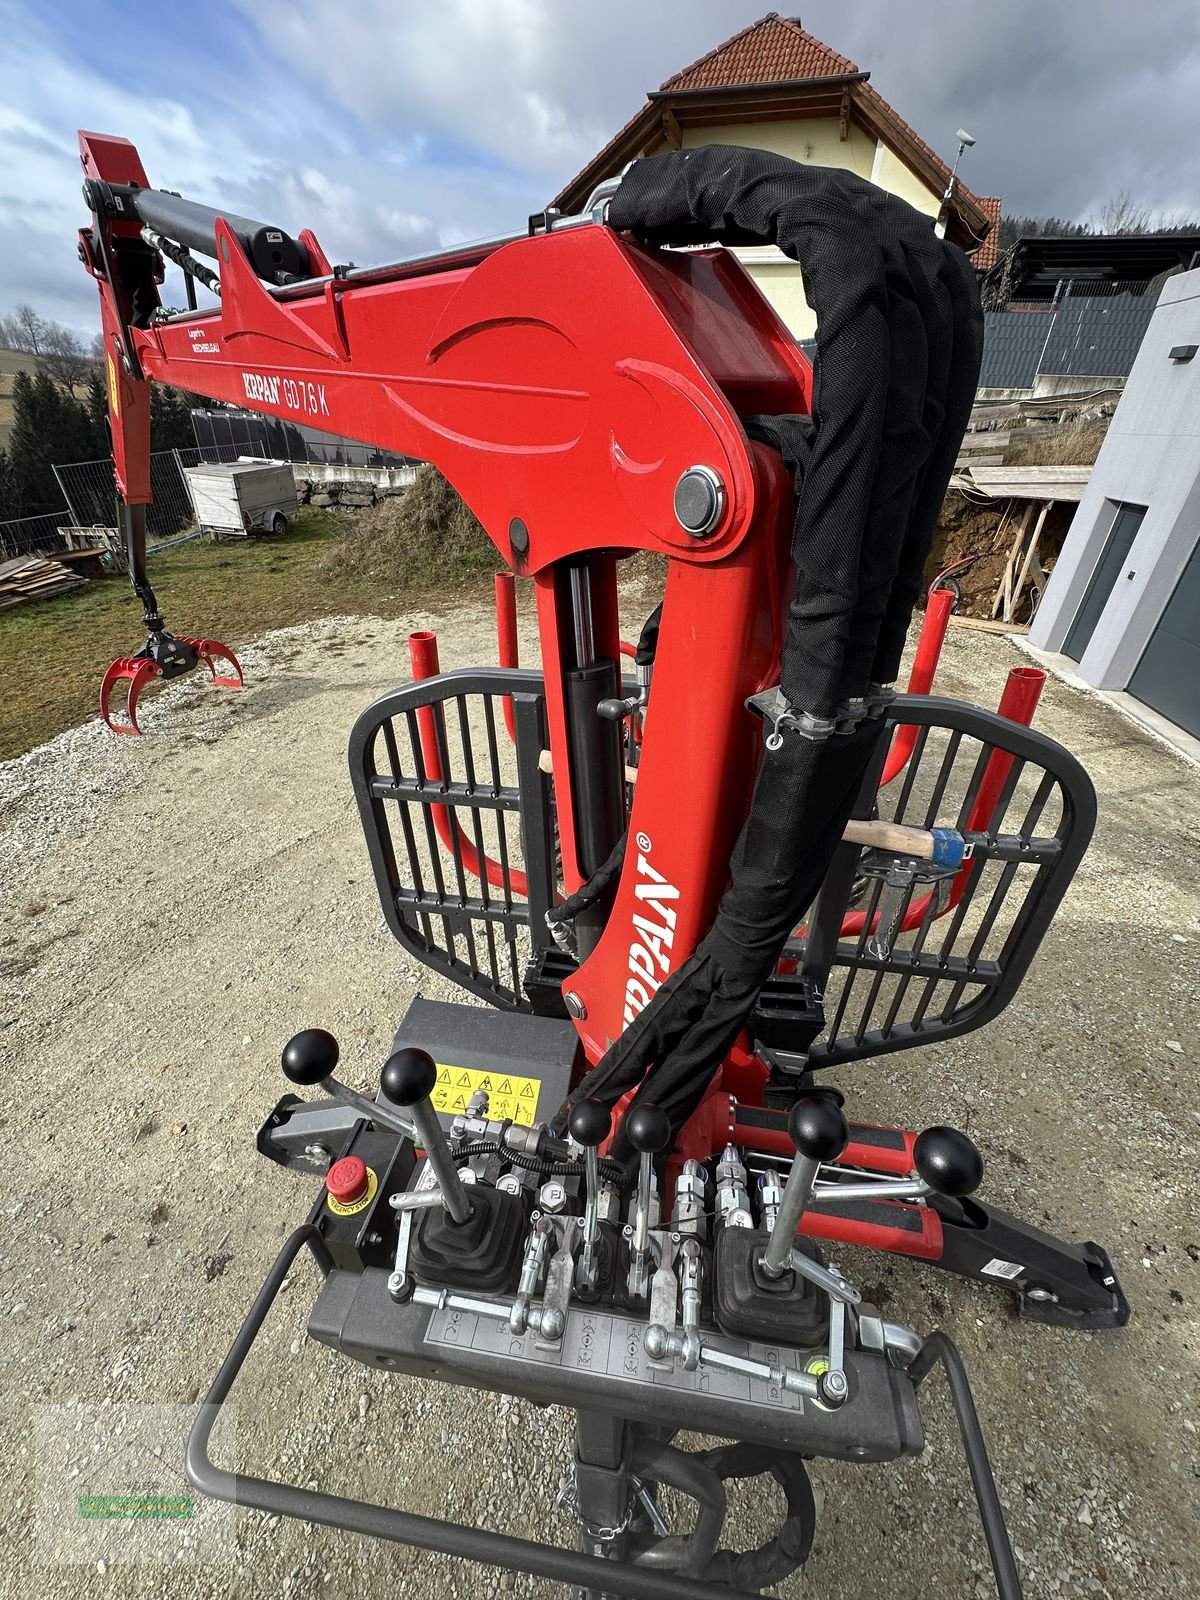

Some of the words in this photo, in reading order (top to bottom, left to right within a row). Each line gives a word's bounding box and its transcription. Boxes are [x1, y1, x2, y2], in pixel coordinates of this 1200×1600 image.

[283, 378, 300, 410] GD
[298, 380, 318, 417] 7,6
[317, 383, 331, 417] K
